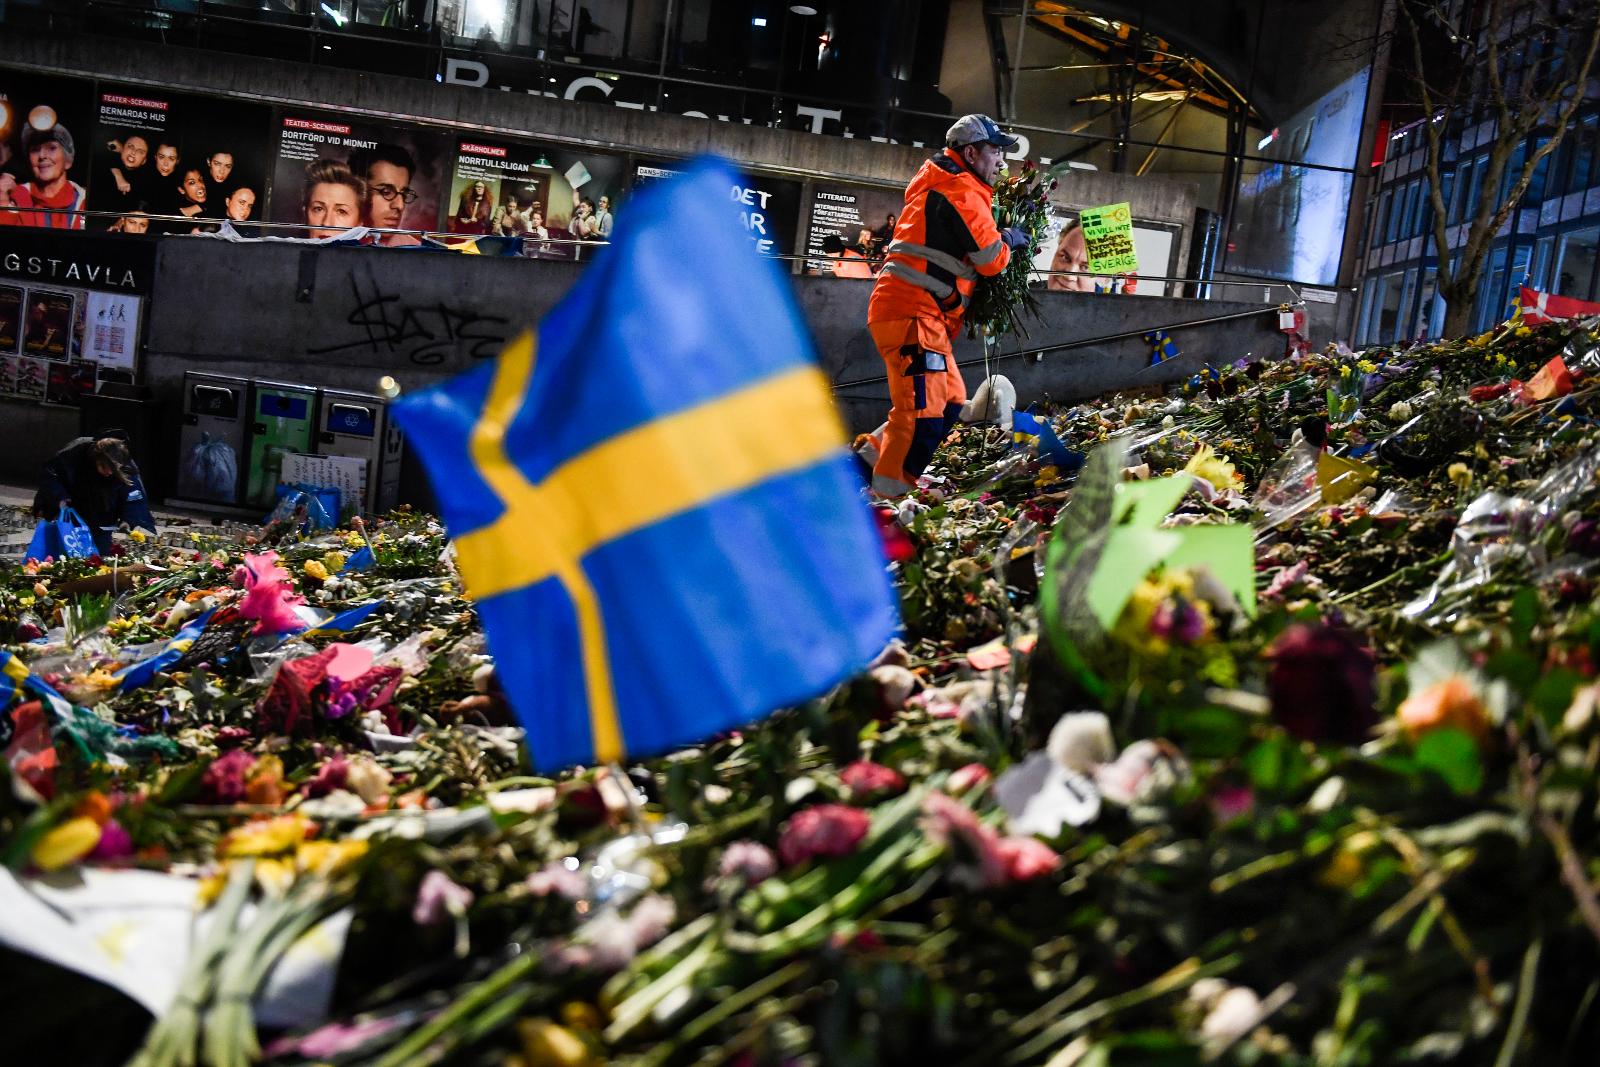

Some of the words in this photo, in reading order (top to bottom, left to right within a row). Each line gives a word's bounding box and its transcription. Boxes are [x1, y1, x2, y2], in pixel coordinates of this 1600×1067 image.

[103, 94, 168, 109] TEATER-SCENKONST
[100, 105, 148, 120] BERNARDAS
[149, 112, 166, 122] HUS
[285, 118, 350, 134] TEATER-SCENKONST
[282, 130, 325, 143] BORTFÖRD
[327, 136, 341, 145] VID
[342, 138, 379, 150] MIDNATT
[461, 144, 506, 156] SKÄRHOLMEN
[458, 155, 529, 172] NORRTULLSLIGAN
[817, 192, 856, 203] LITTERATUR
[814, 203, 860, 214] INTERNATIONELL
[1097, 226, 1114, 234] VILL
[1115, 223, 1131, 231] INTE
[1093, 254, 1137, 271] SVERIGE
